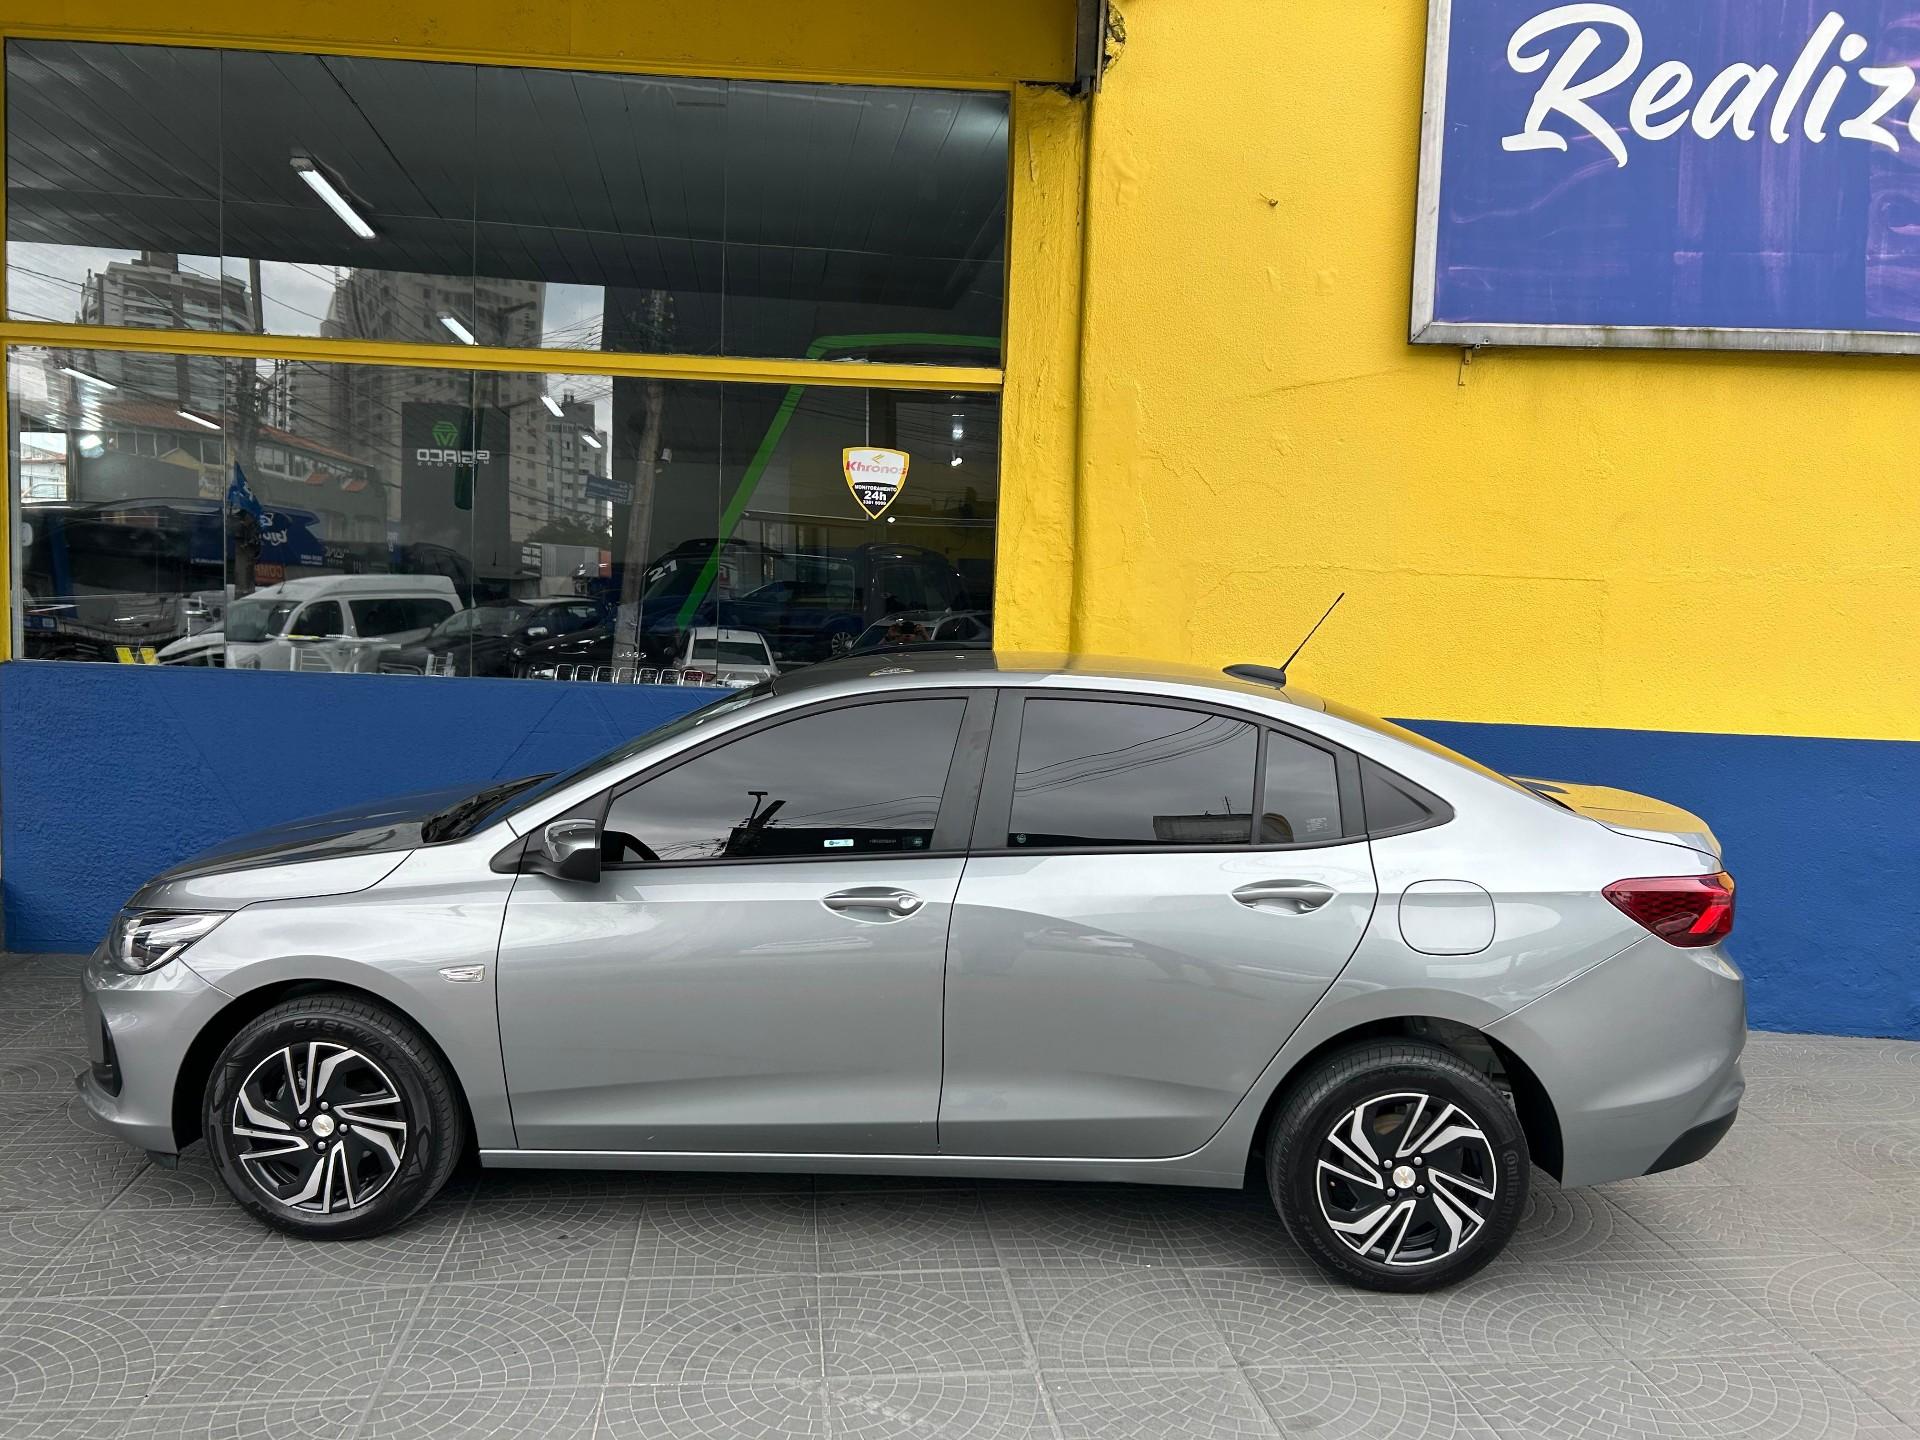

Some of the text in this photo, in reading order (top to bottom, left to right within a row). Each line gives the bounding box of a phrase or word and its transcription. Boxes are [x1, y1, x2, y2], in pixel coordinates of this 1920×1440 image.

[1501, 3, 1920, 168] Realiz
[846, 461, 906, 475] Khronos
[864, 490, 887, 500] 24h
